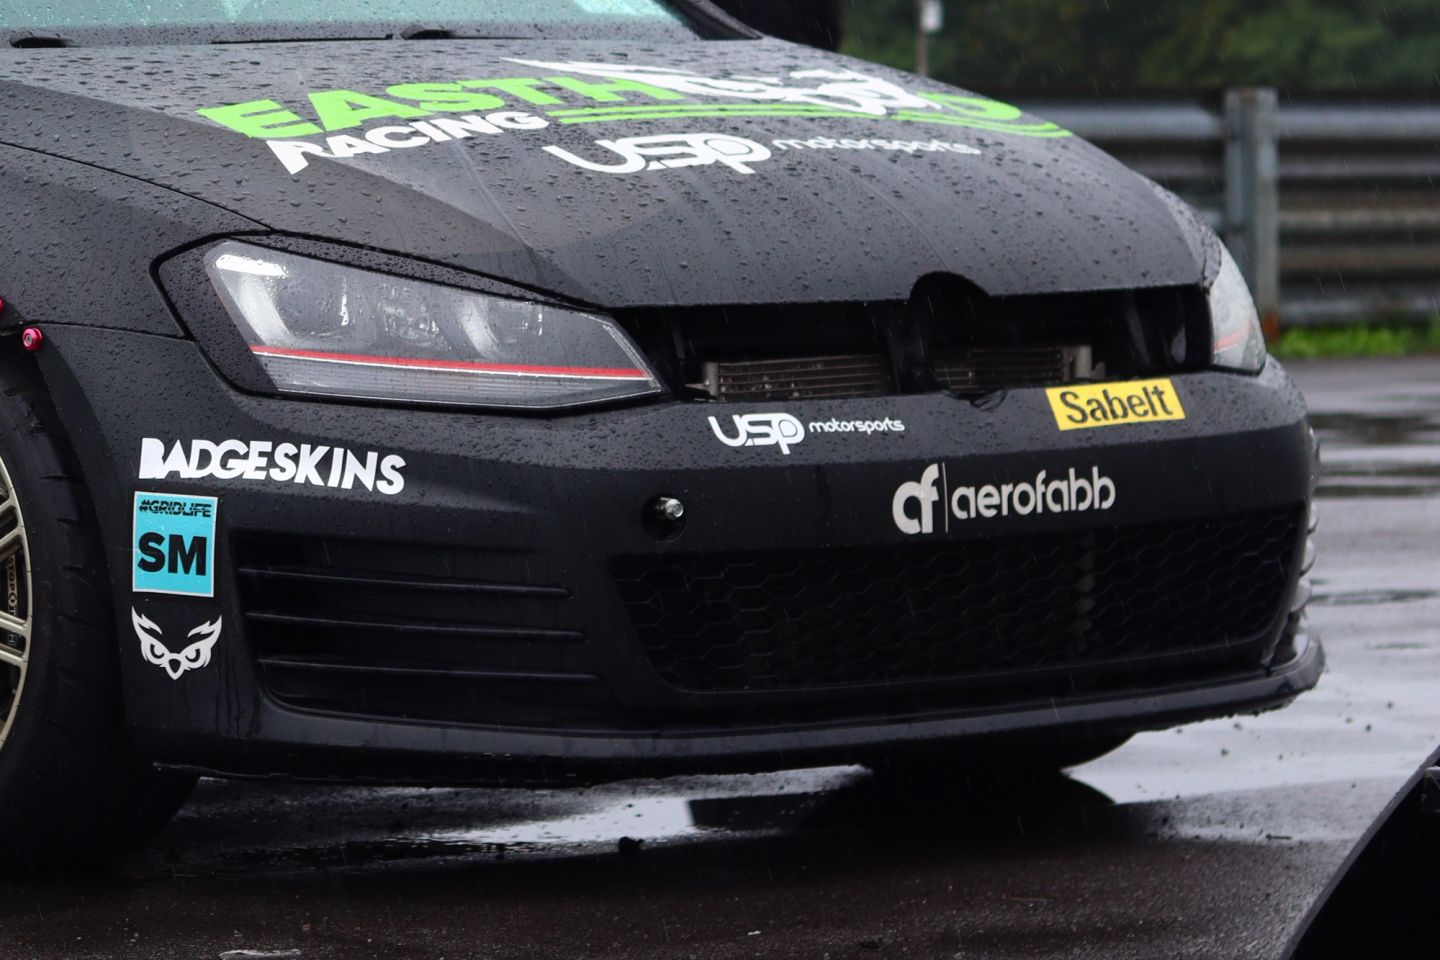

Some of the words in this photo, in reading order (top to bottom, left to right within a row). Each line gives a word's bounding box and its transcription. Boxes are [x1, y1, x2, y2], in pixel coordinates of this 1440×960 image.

[264, 111, 550, 175] RACING
[542, 133, 771, 174] USP
[772, 136, 981, 155] motorsports
[1061, 385, 1173, 424] Sabelt
[708, 413, 805, 454] USP
[809, 417, 905, 435] motorsports
[139, 437, 407, 495] BADGESKINS
[139, 499, 212, 518] #GRIDLIFE
[951, 466, 1116, 520] aerofabb
[137, 532, 208, 576] SM
